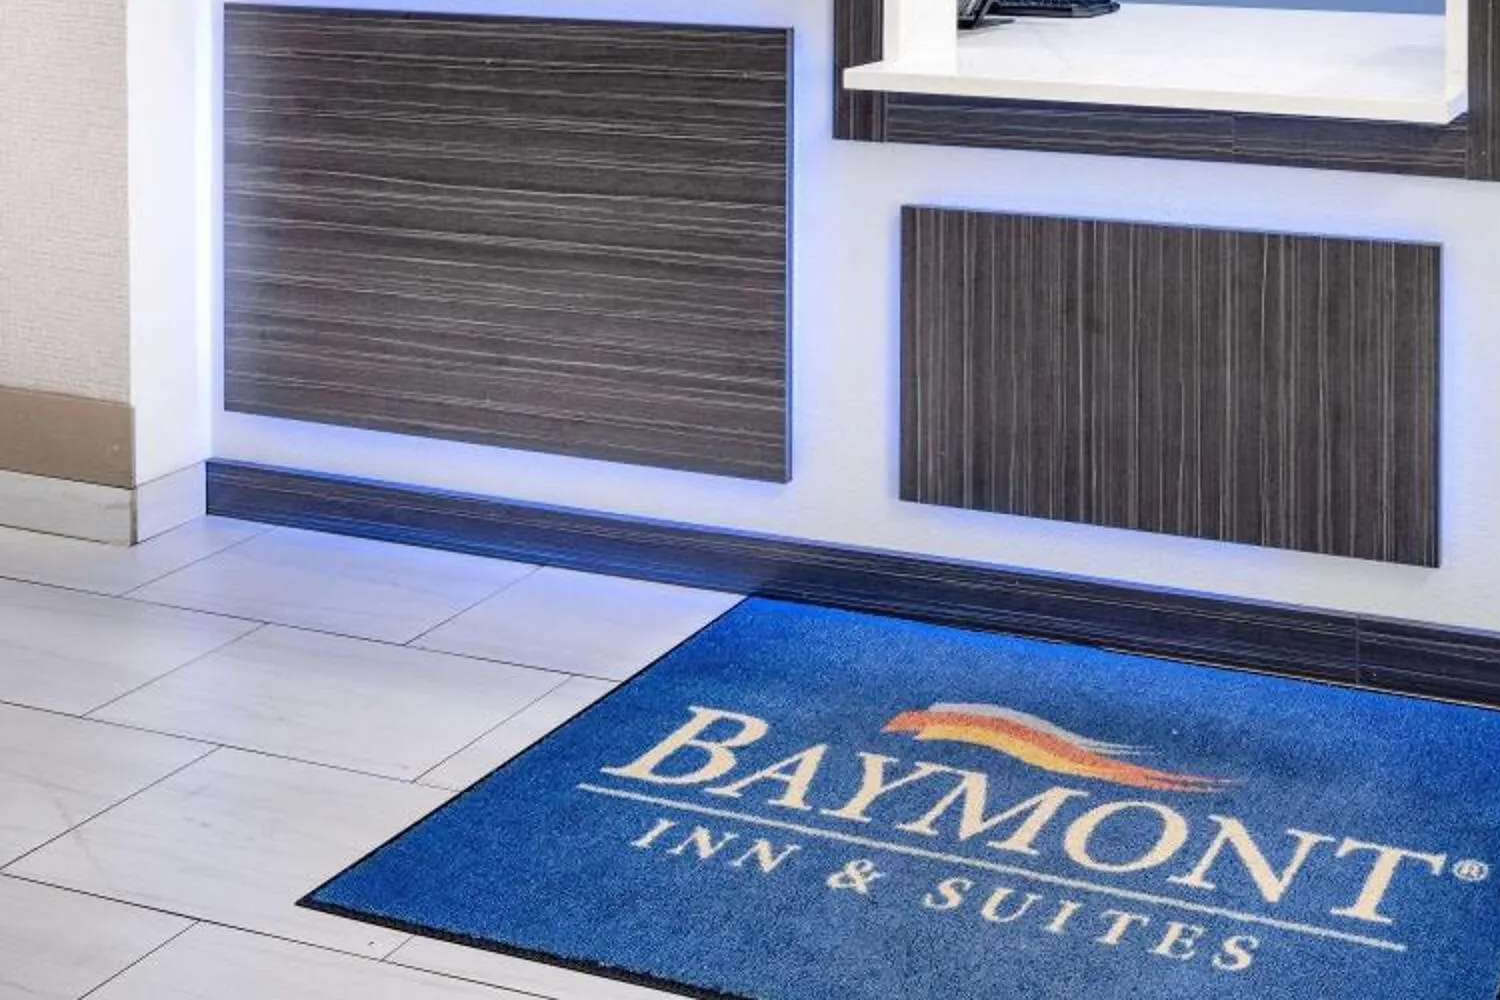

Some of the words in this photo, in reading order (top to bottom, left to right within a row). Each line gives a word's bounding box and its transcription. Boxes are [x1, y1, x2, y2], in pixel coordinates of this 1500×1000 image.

[630, 818, 802, 874] INN
[827, 858, 887, 895] &
[924, 876, 1261, 972] SUITES
